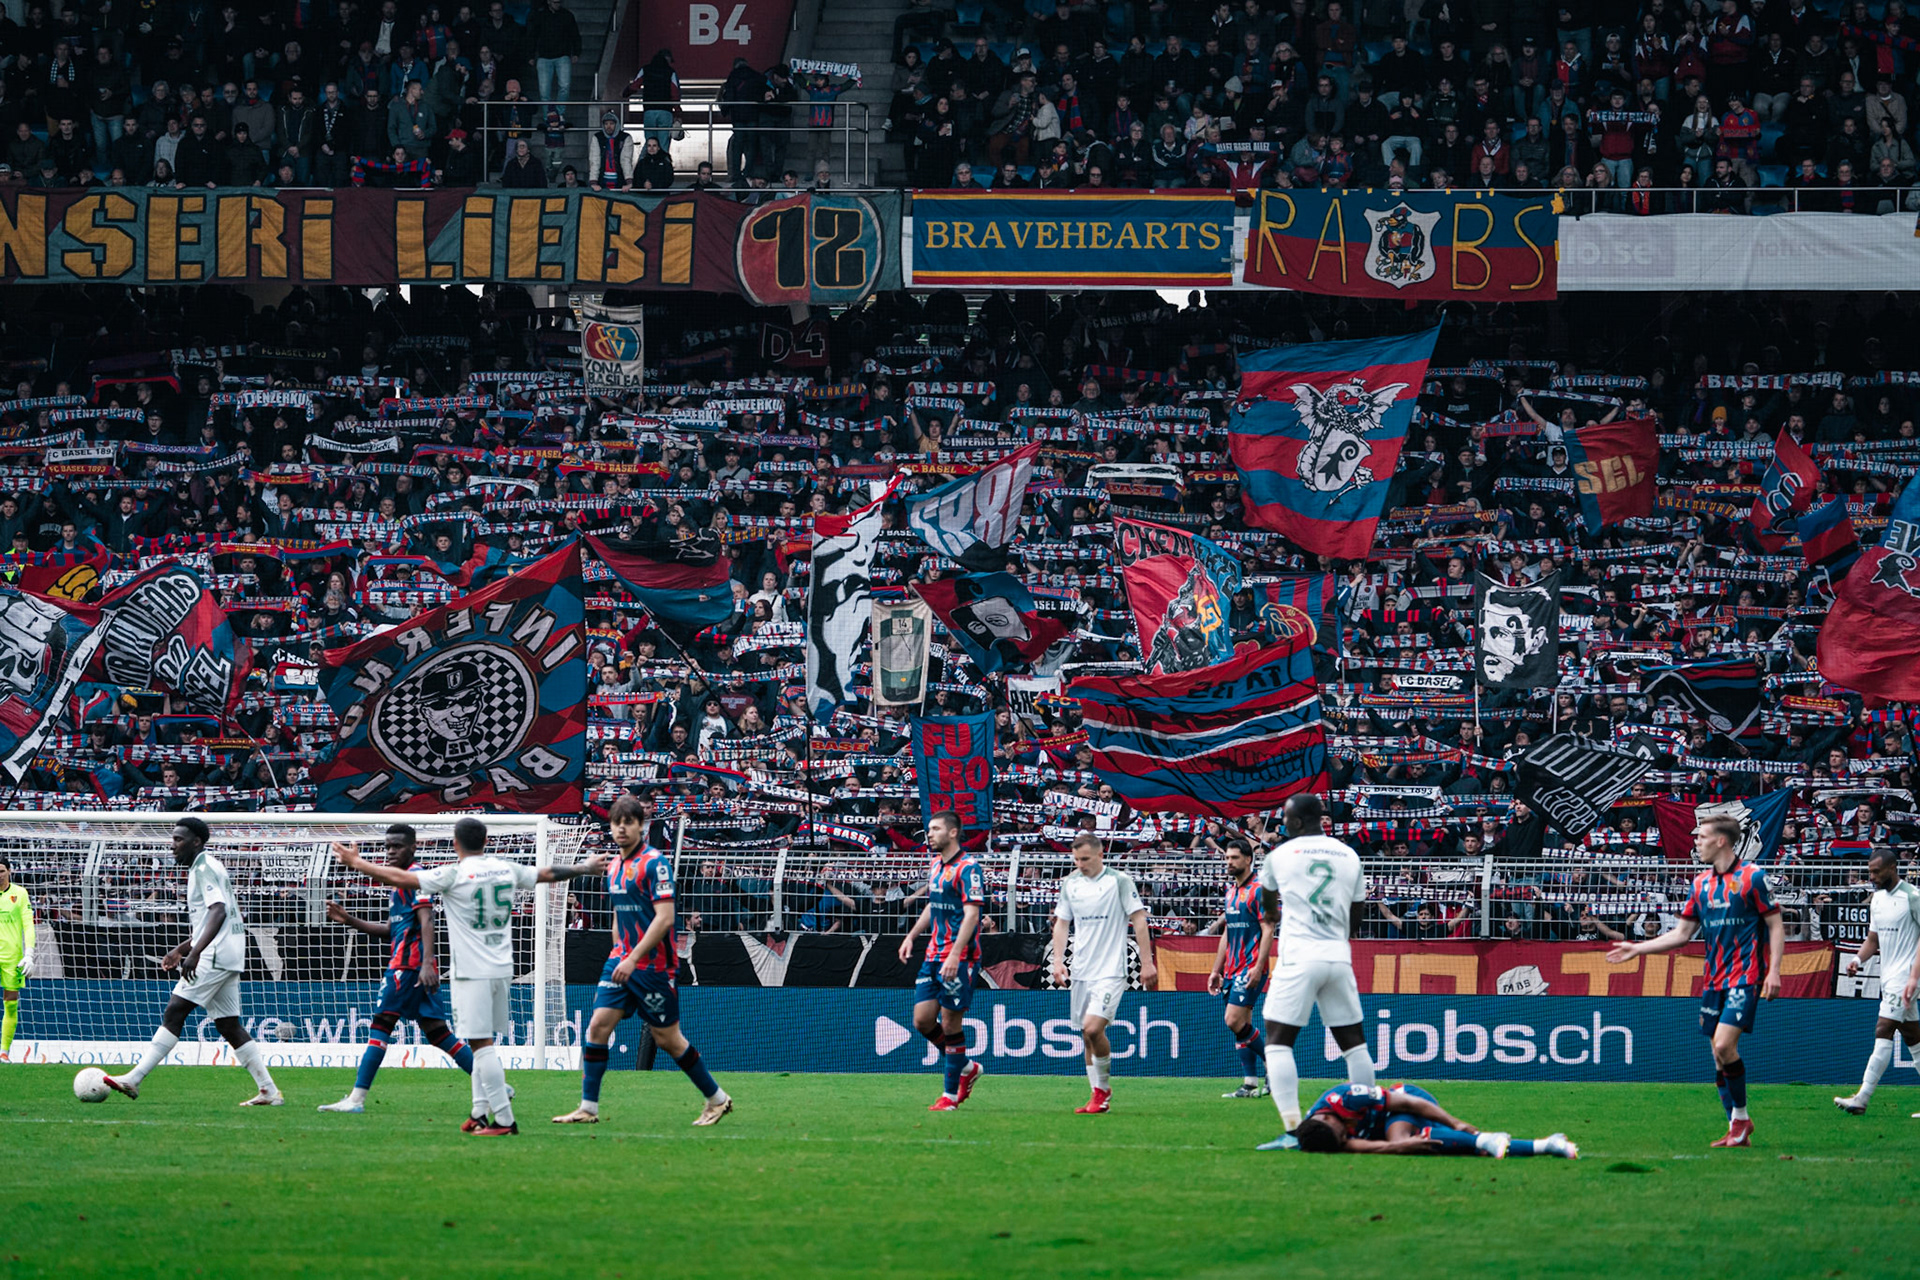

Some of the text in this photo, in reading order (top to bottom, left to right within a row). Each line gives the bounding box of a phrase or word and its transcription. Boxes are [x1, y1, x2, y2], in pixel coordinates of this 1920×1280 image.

[687, 3, 752, 46] B4
[924, 220, 1222, 250] BRAVEHEARTS
[760, 319, 827, 363] D4
[585, 360, 624, 381] ZONA
[587, 375, 642, 393] BASILEA
[911, 381, 988, 395] BASEL
[1707, 374, 1784, 390] BASEL
[805, 411, 881, 431] BASEL
[61, 448, 93, 461] BASEL
[49, 464, 58, 475] FC
[61, 464, 87, 475] BASEL
[88, 465, 107, 475] 1893
[593, 463, 640, 475] FC BASEL
[919, 463, 957, 476] BASEL
[1695, 485, 1715, 497] FC
[301, 507, 382, 521] BASEL
[368, 591, 455, 605] BASEL
[1399, 675, 1455, 690] FC BASEL
[1049, 696, 1073, 708] FC
[813, 739, 870, 754] BASEL
[1685, 756, 1800, 774] MUTTENZERURVE
[1357, 787, 1434, 800] FC BASEL 1893
[812, 822, 871, 847] FC BASEL
[1308, 859, 1336, 905] 2
[472, 883, 514, 930] 15
[1838, 906, 1868, 922] FIGG
[1103, 992, 1112, 1005] 8
[1371, 1008, 1634, 1072] jobs.ch
